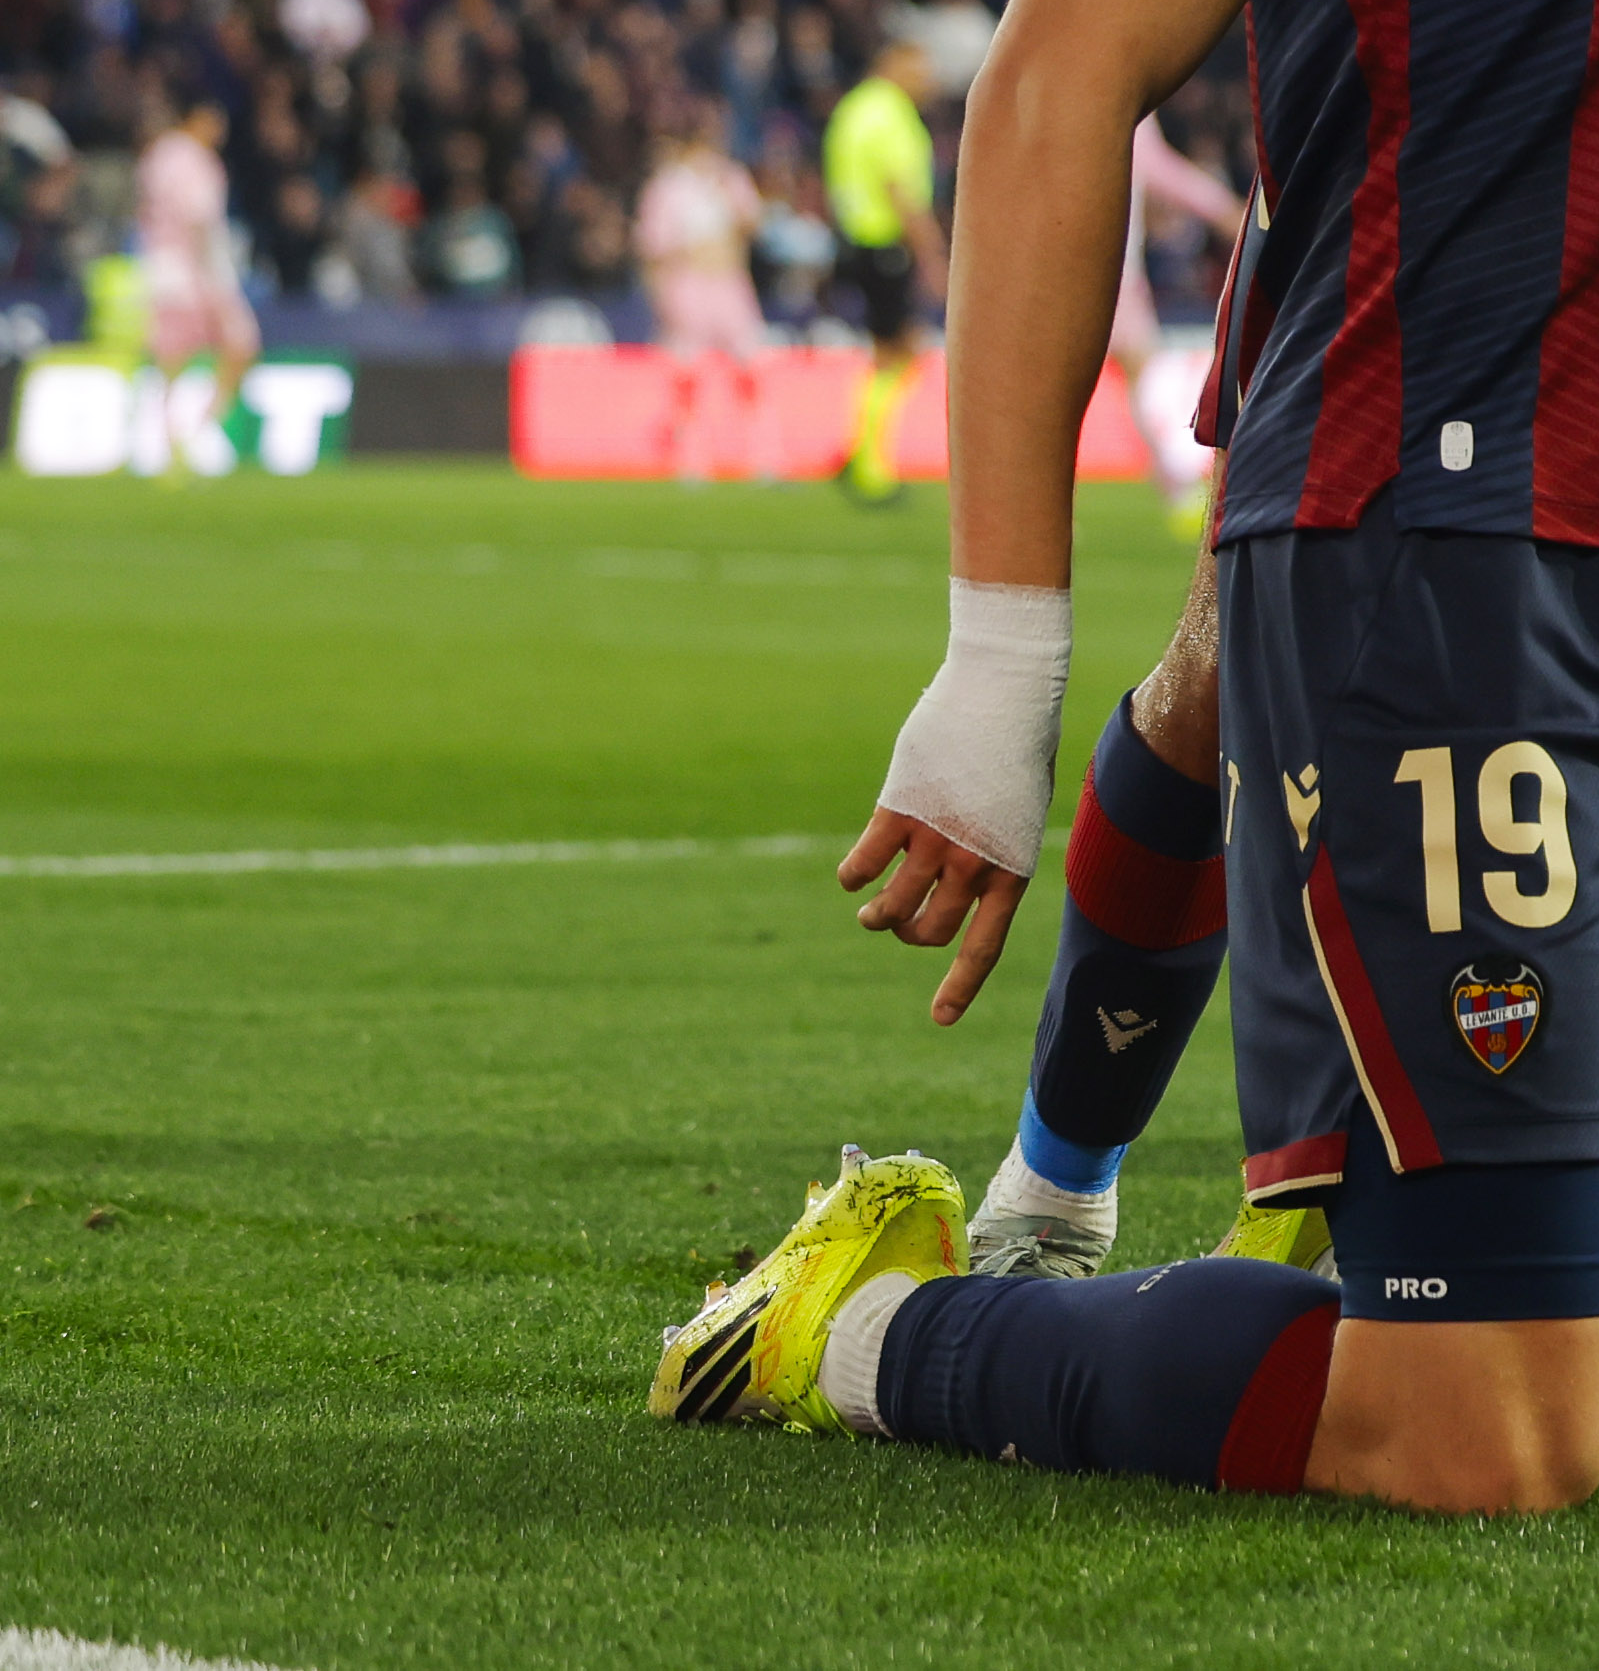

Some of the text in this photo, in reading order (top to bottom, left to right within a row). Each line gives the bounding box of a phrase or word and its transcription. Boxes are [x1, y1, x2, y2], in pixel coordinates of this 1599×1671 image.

[1394, 740, 1577, 932] 19
[1466, 1009, 1508, 1027] LEVANTE
[1384, 1277, 1448, 1300] PRO
